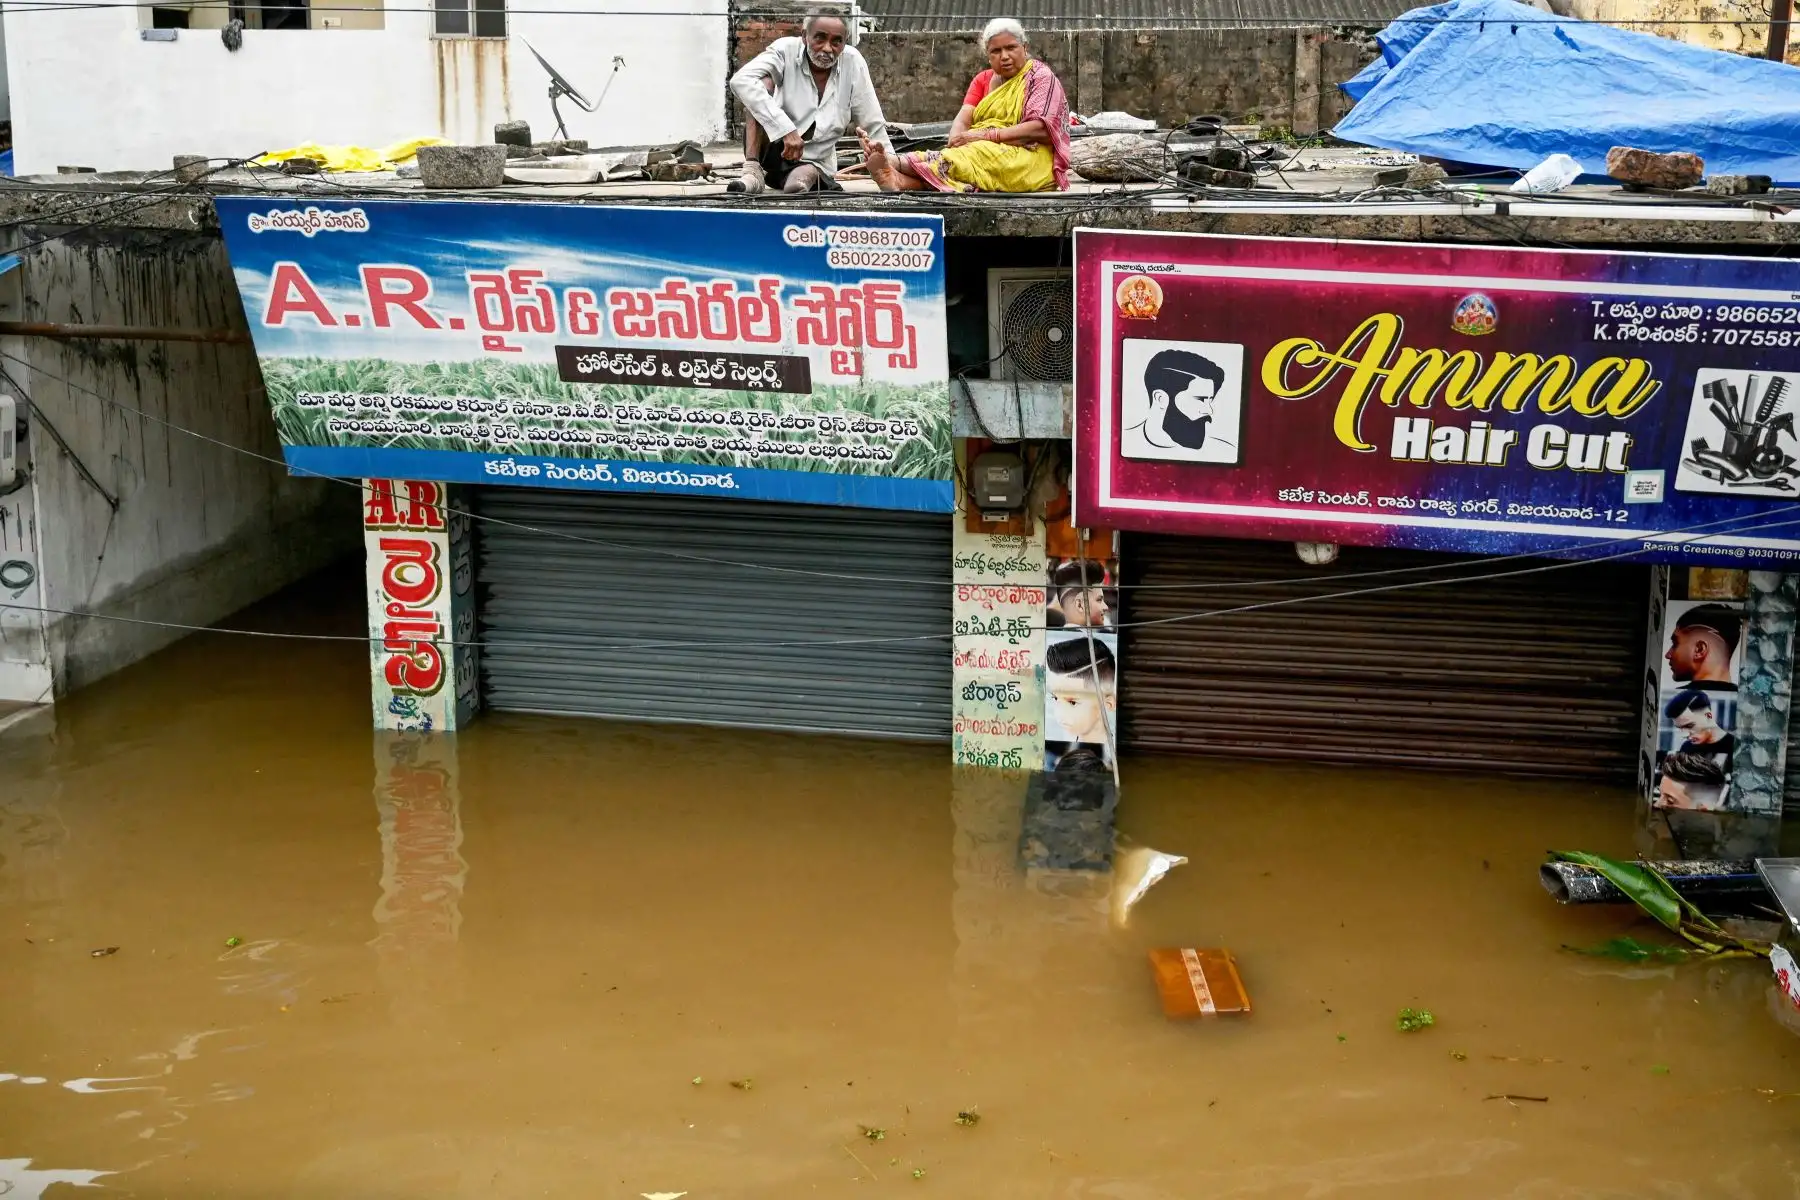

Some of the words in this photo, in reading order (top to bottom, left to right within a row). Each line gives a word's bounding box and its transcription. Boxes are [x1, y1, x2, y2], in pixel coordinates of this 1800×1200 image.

[272, 211, 321, 233] సయ్యద్
[787, 228, 823, 243] Cell:
[829, 230, 931, 246] 7989687007
[830, 252, 931, 268] 8500223007
[470, 269, 556, 352] రైస్
[568, 291, 600, 336] &
[794, 283, 917, 376] స్టోర్స్
[1609, 301, 1657, 324] అప్పల
[1716, 305, 1800, 323] 986652
[661, 363, 674, 377] &
[1261, 312, 1662, 451] Amma
[298, 393, 325, 407] మా
[328, 394, 356, 412] వద్ద
[359, 395, 391, 413] అన్ని
[391, 395, 453, 411] రకముల
[889, 420, 919, 441] రైస్
[527, 427, 592, 442] మరియు
[674, 434, 708, 450] పాత
[1391, 416, 1517, 466] Hair
[1526, 424, 1633, 473] Cut
[1377, 495, 1416, 510] రామ
